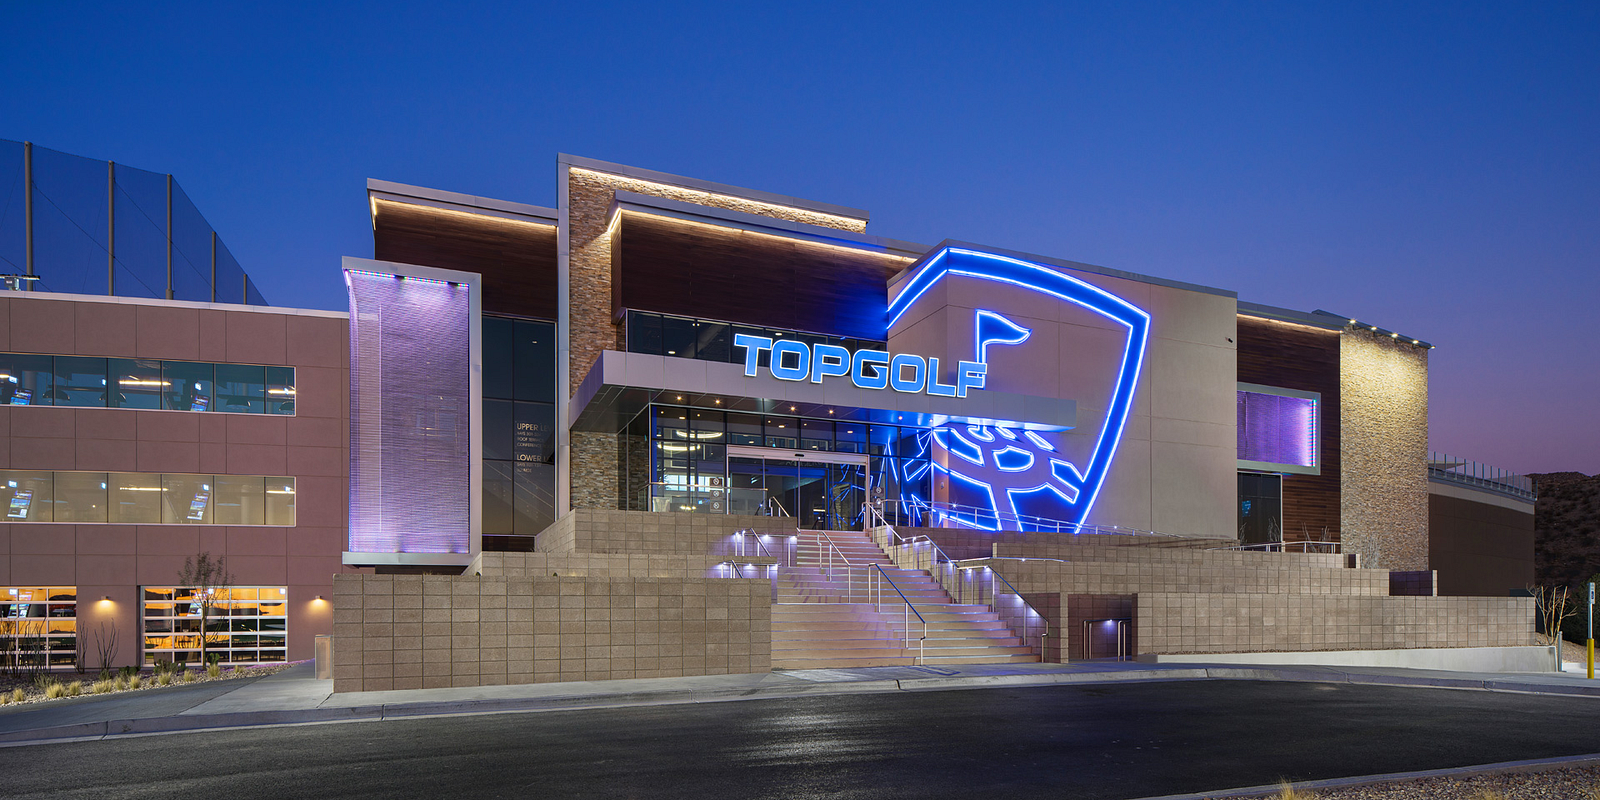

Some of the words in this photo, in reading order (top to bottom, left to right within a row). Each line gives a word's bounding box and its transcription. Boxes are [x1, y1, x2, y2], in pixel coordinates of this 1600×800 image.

[734, 333, 987, 398] TOPGOLF
[517, 423, 538, 431] UPPER
[517, 454, 541, 462] LOWER
